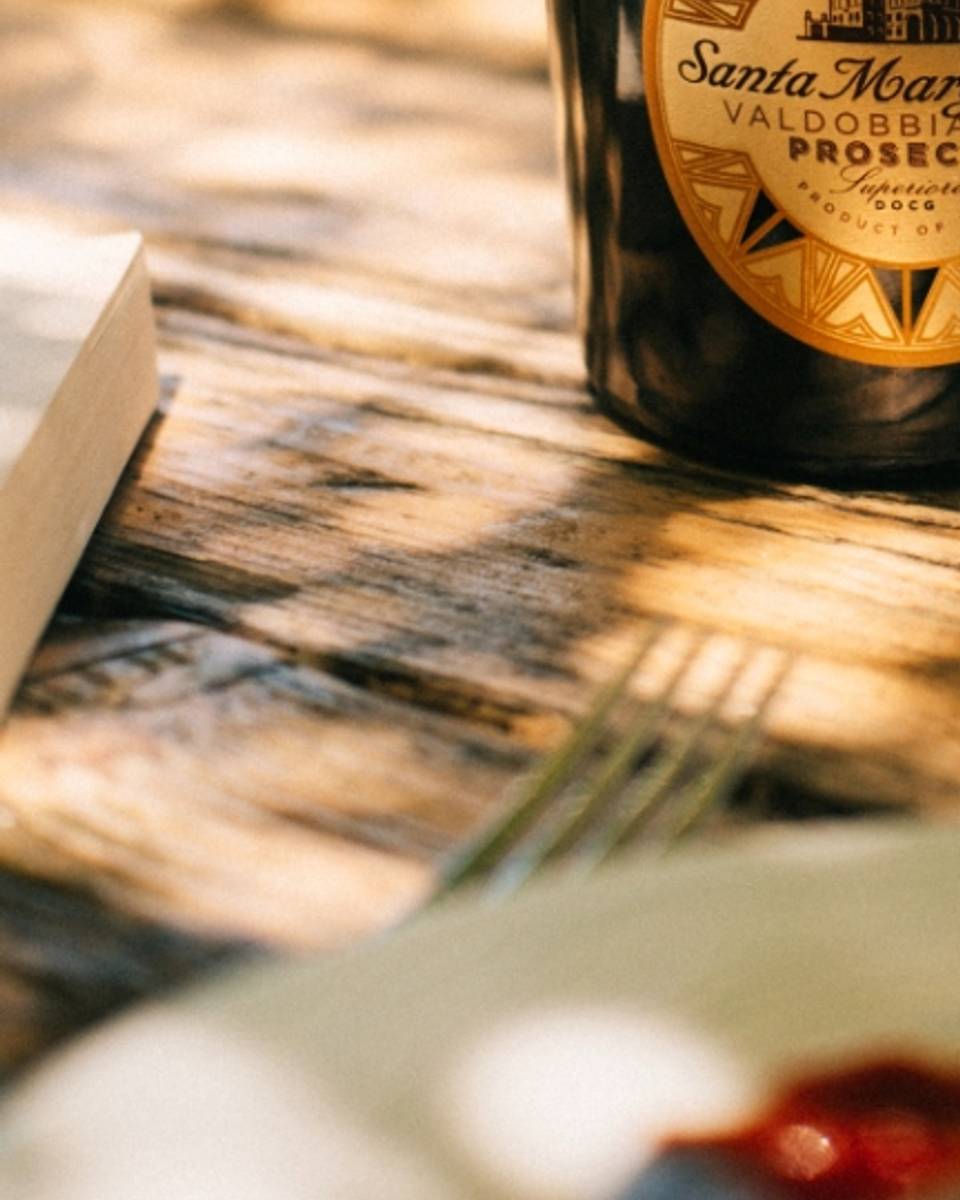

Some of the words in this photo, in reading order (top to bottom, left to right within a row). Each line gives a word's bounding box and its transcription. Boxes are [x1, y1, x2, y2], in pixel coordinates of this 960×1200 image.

[677, 38, 818, 98] Santa
[798, 181, 899, 236] PRODUCT
[916, 222, 944, 236] OF
[874, 200, 935, 211] DOCG
